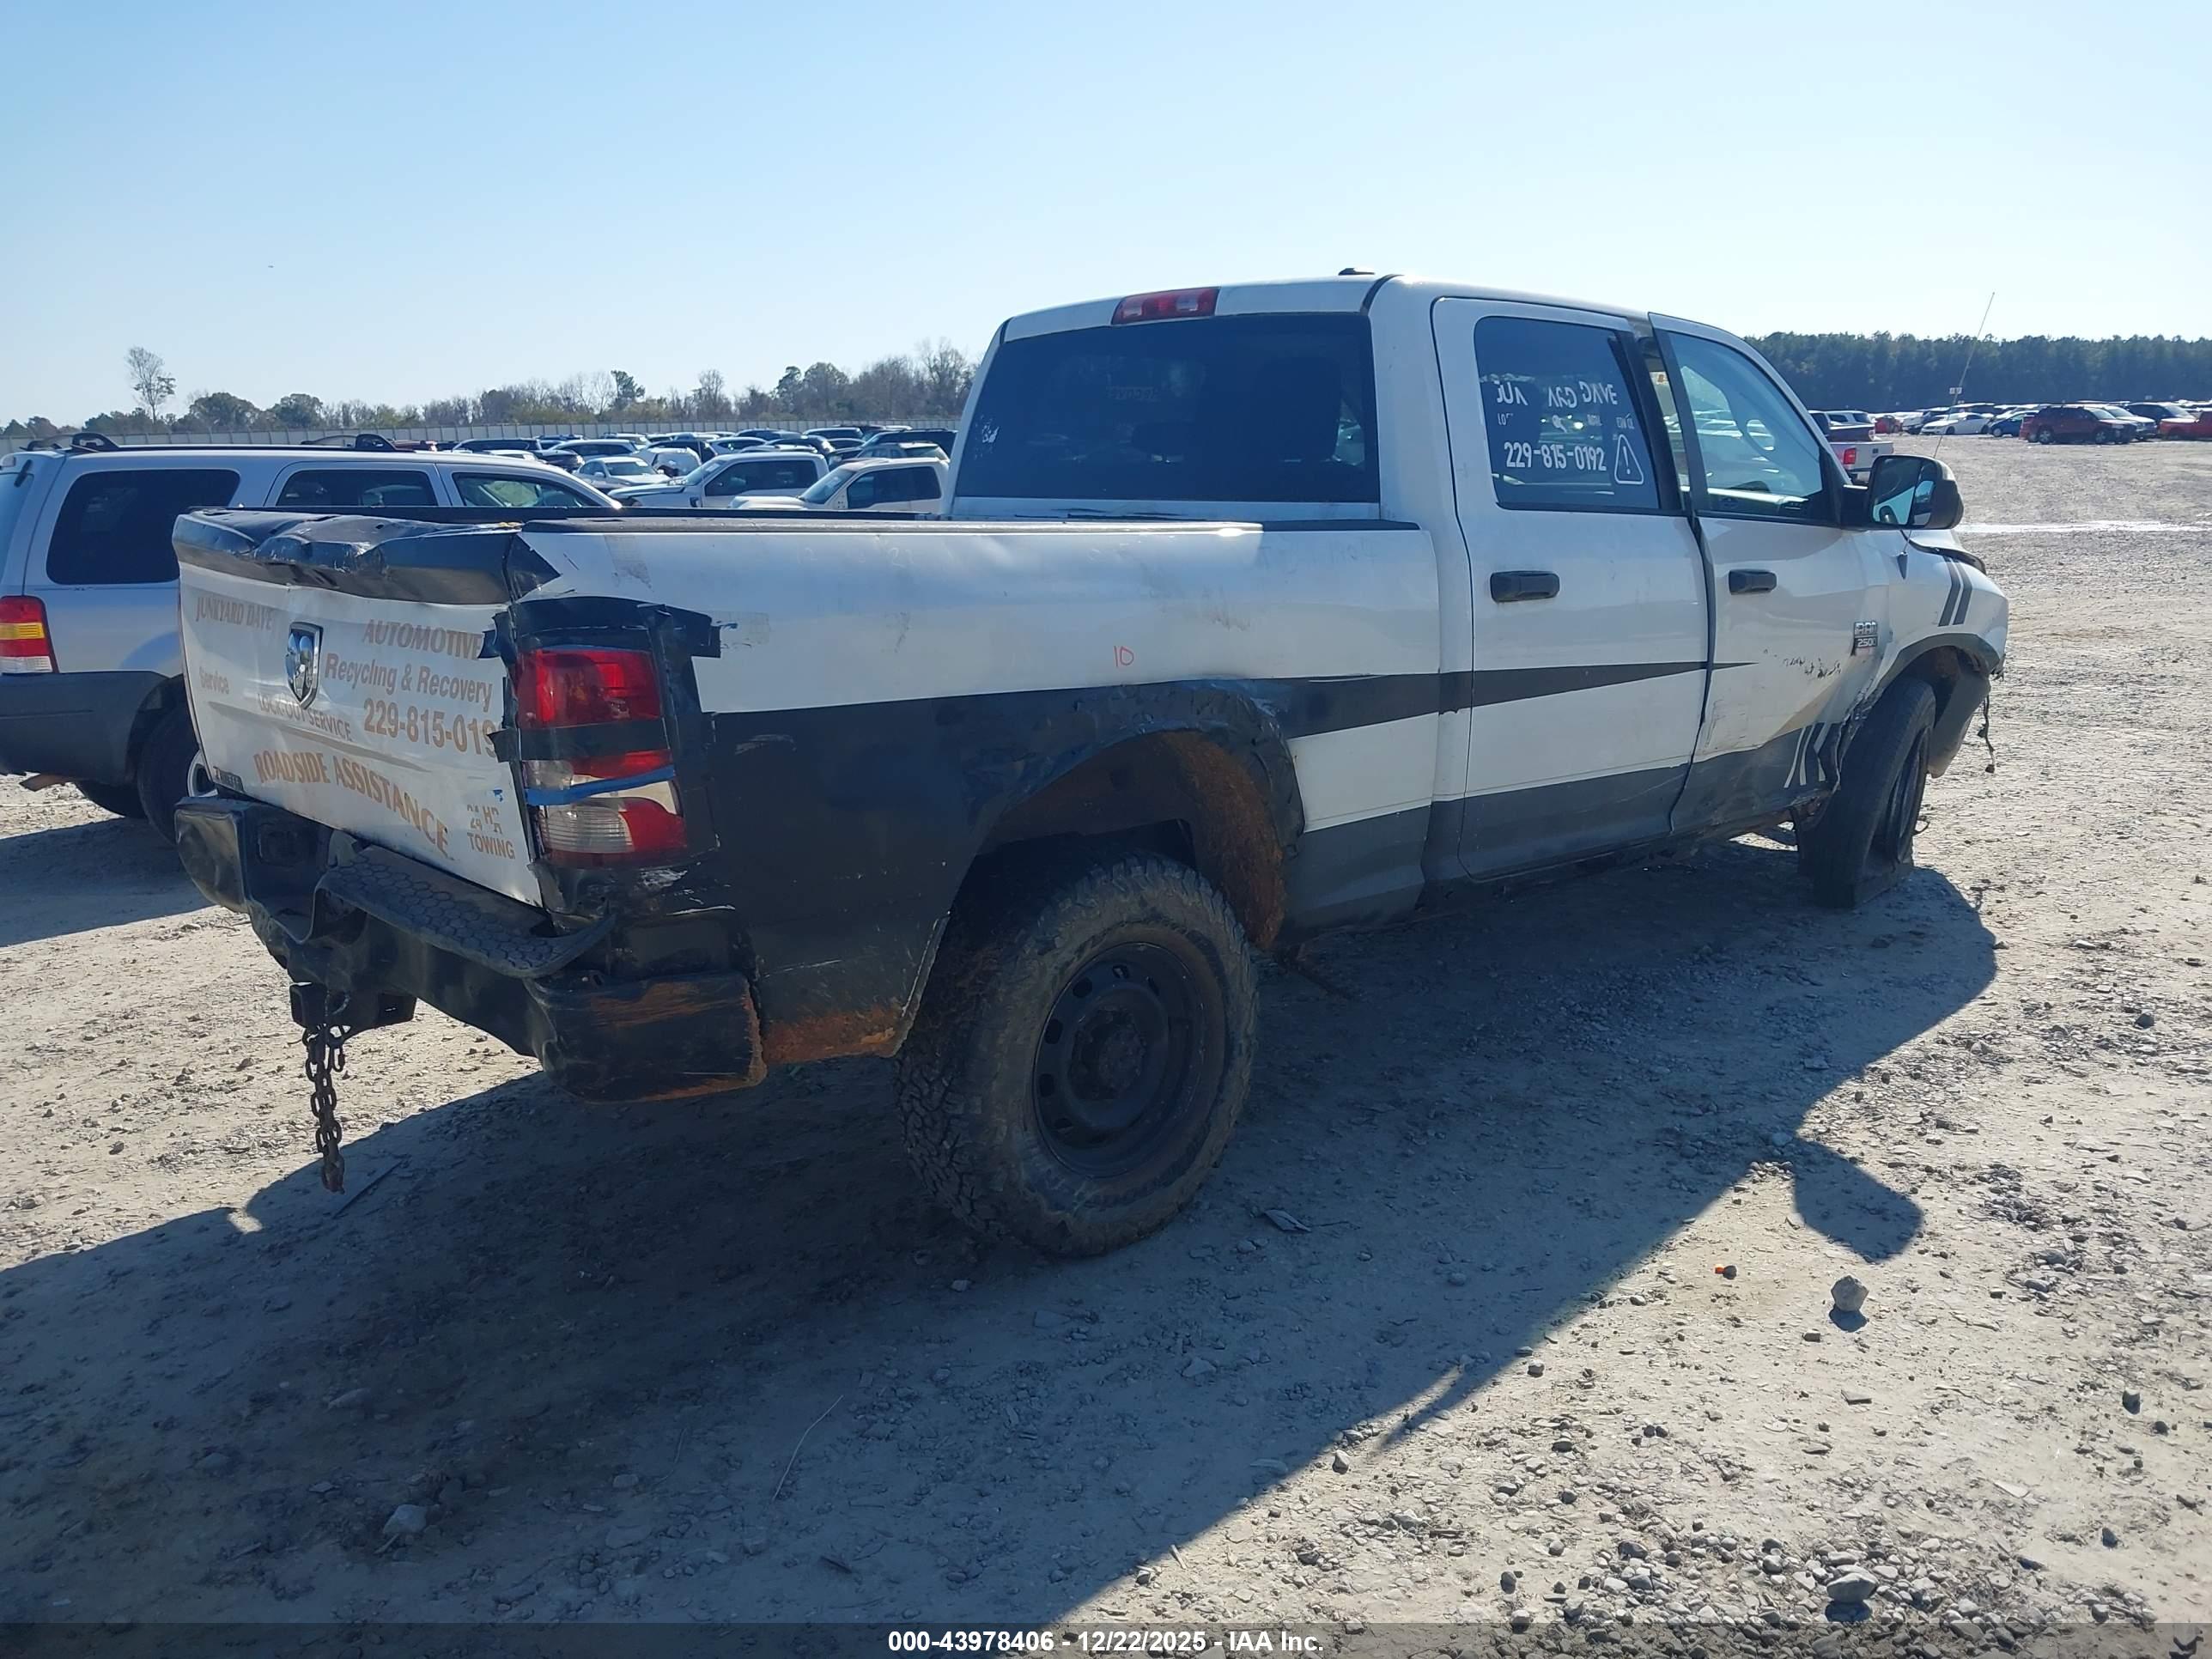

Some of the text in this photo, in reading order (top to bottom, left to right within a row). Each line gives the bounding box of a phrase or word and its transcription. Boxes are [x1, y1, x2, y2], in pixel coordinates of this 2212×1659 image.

[1504, 441, 1607, 471] 229-815-0192
[196, 597, 244, 625] JUNKYARD
[363, 619, 486, 660] AUTOMOTIVE
[198, 665, 229, 695] Service
[325, 653, 493, 713] Recycling & Recovery
[307, 708, 353, 742] SERVICE
[363, 697, 501, 758] 229-815-019
[253, 750, 454, 860] ROADSIDE ASSISTANCE
[466, 832, 516, 860] TOWING
